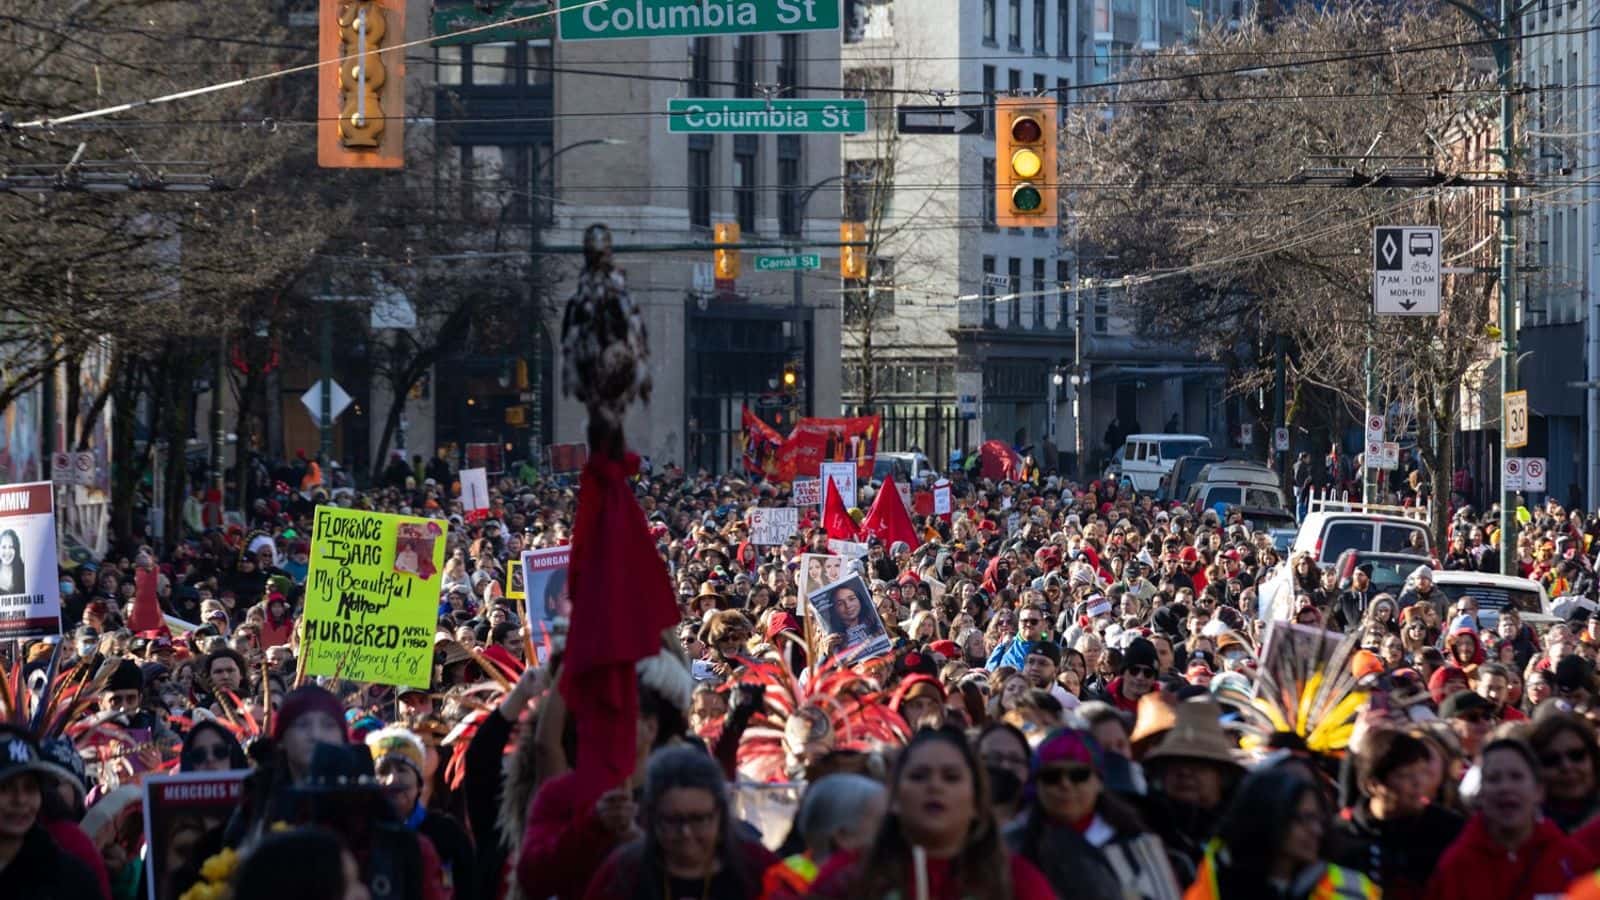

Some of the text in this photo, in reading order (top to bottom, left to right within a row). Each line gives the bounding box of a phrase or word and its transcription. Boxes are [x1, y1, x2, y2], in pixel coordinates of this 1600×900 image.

[582, 0, 817, 32] Columbia St
[685, 105, 850, 127] Columbia St
[760, 256, 814, 269] Carrall St
[1511, 408, 1525, 432] 30
[316, 511, 383, 541] FLORENCE
[322, 540, 382, 566] ISAAC
[535, 555, 570, 568] MORGAN
[314, 567, 412, 606] My Beautiful
[336, 591, 388, 621] Mother
[305, 619, 400, 649] MURDERED
[402, 626, 431, 637] APRIL
[164, 783, 227, 800] MERCEDES
